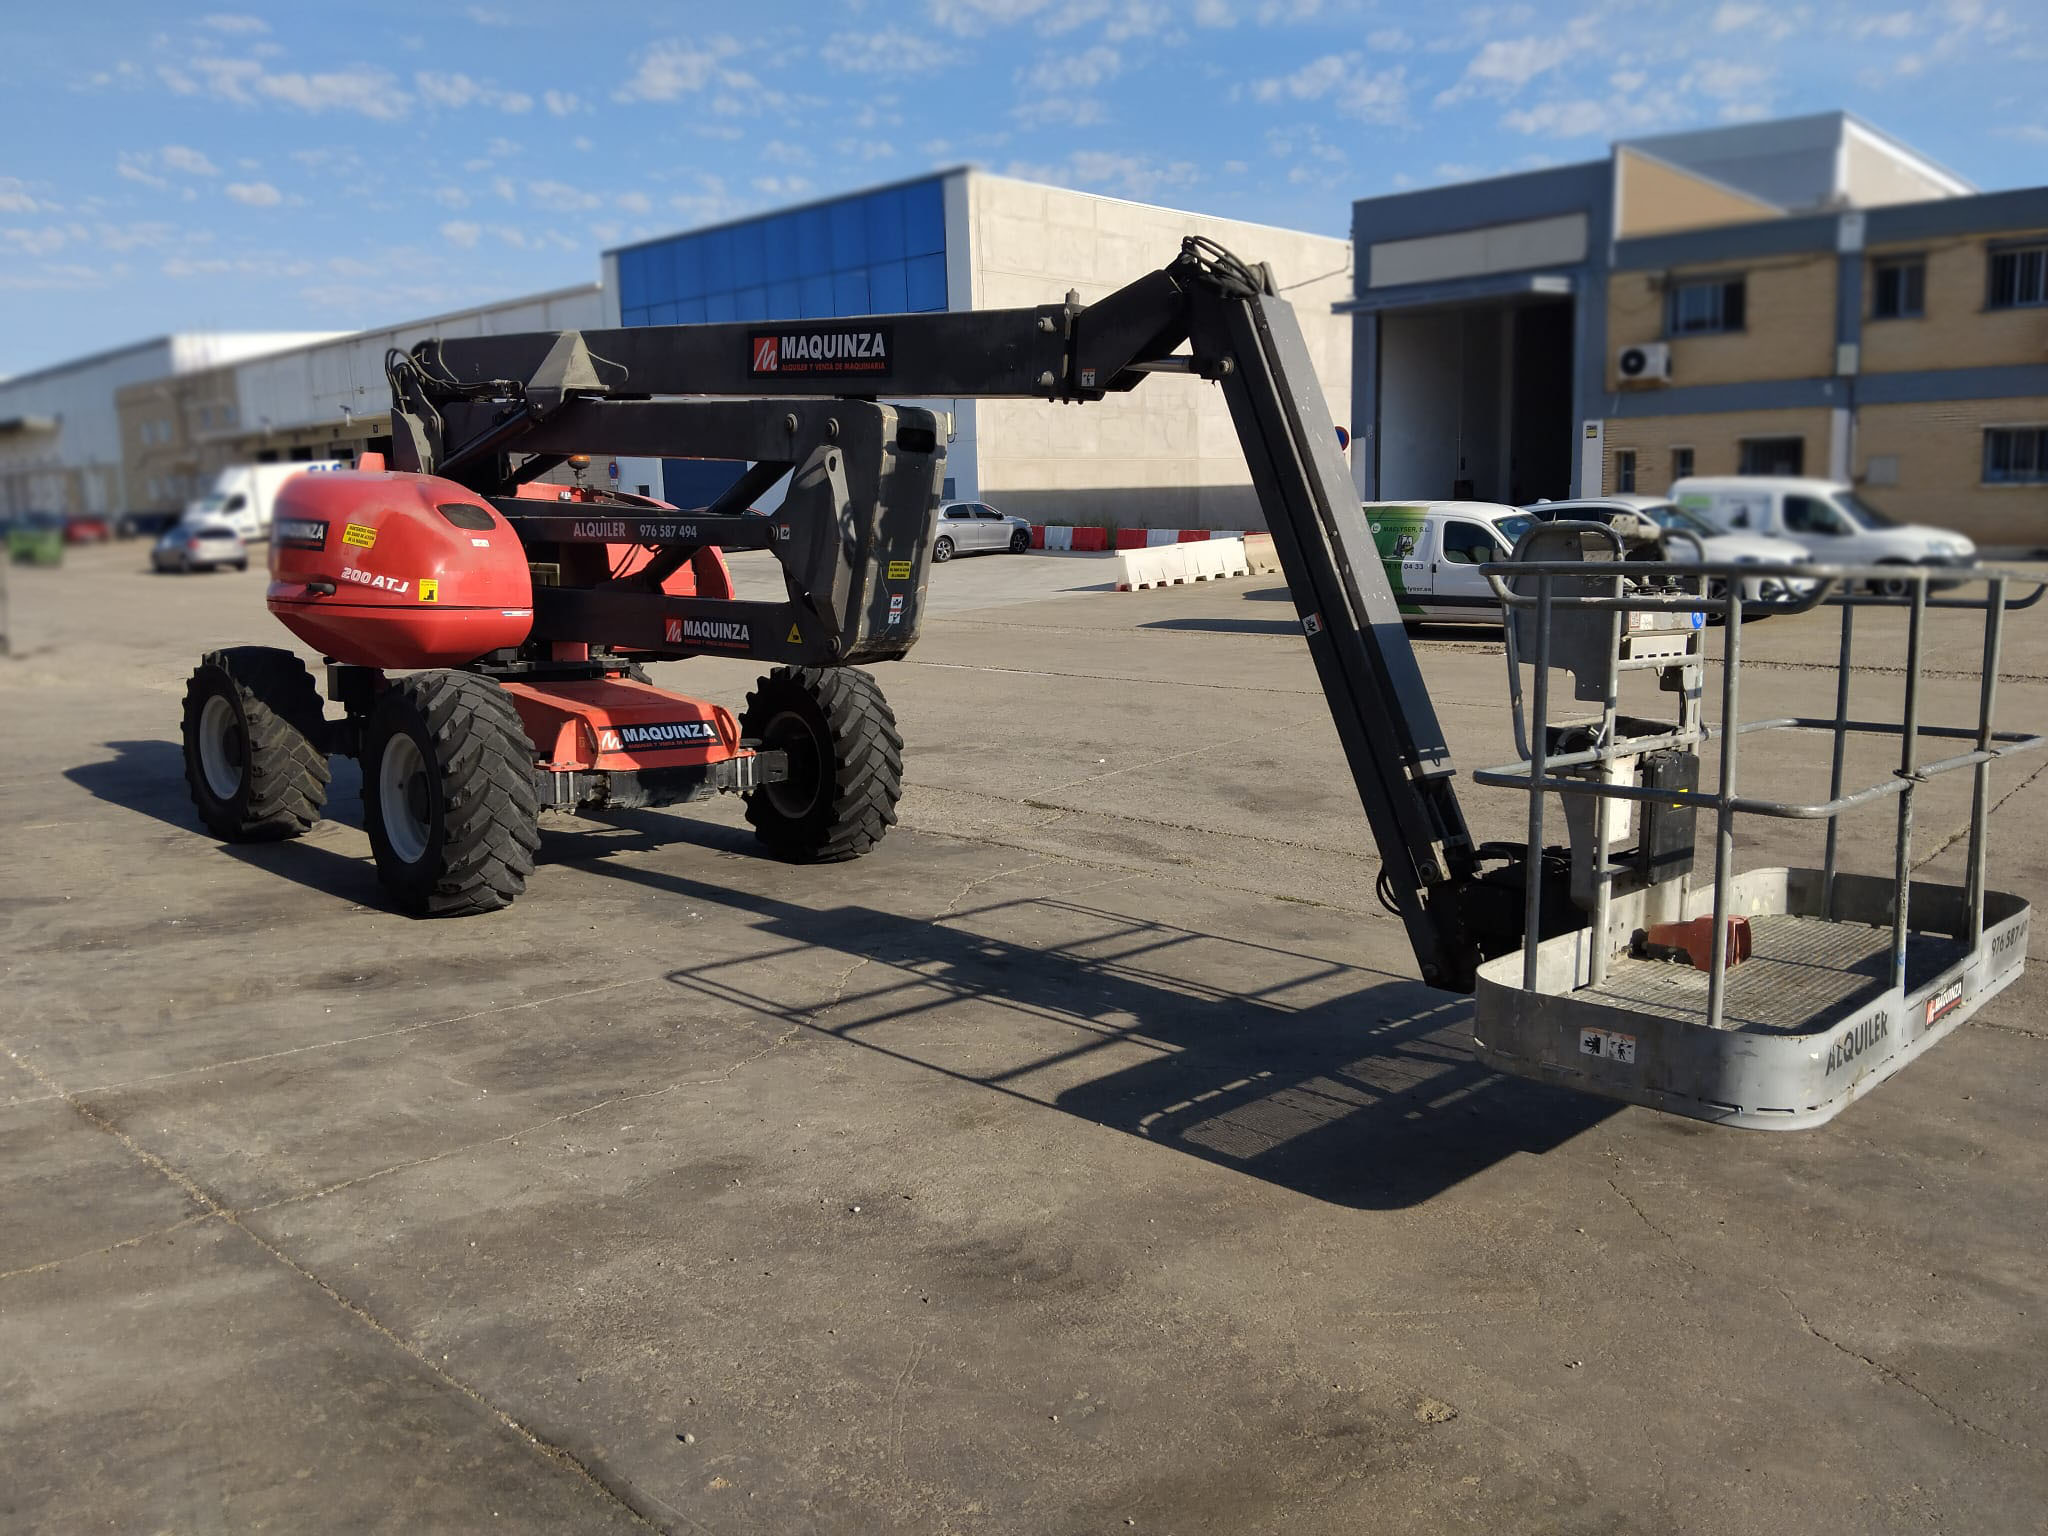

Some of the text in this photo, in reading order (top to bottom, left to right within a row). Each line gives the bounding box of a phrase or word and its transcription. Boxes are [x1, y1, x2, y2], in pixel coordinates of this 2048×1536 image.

[781, 332, 886, 360] MAQUINZA
[573, 522, 697, 538] ALQUILER 976 587 494
[341, 567, 410, 593] 200 ATJ
[683, 619, 750, 641] MAQUINZA
[621, 722, 716, 743] MAQUINZA
[1825, 1010, 1889, 1077] ALQUILER
